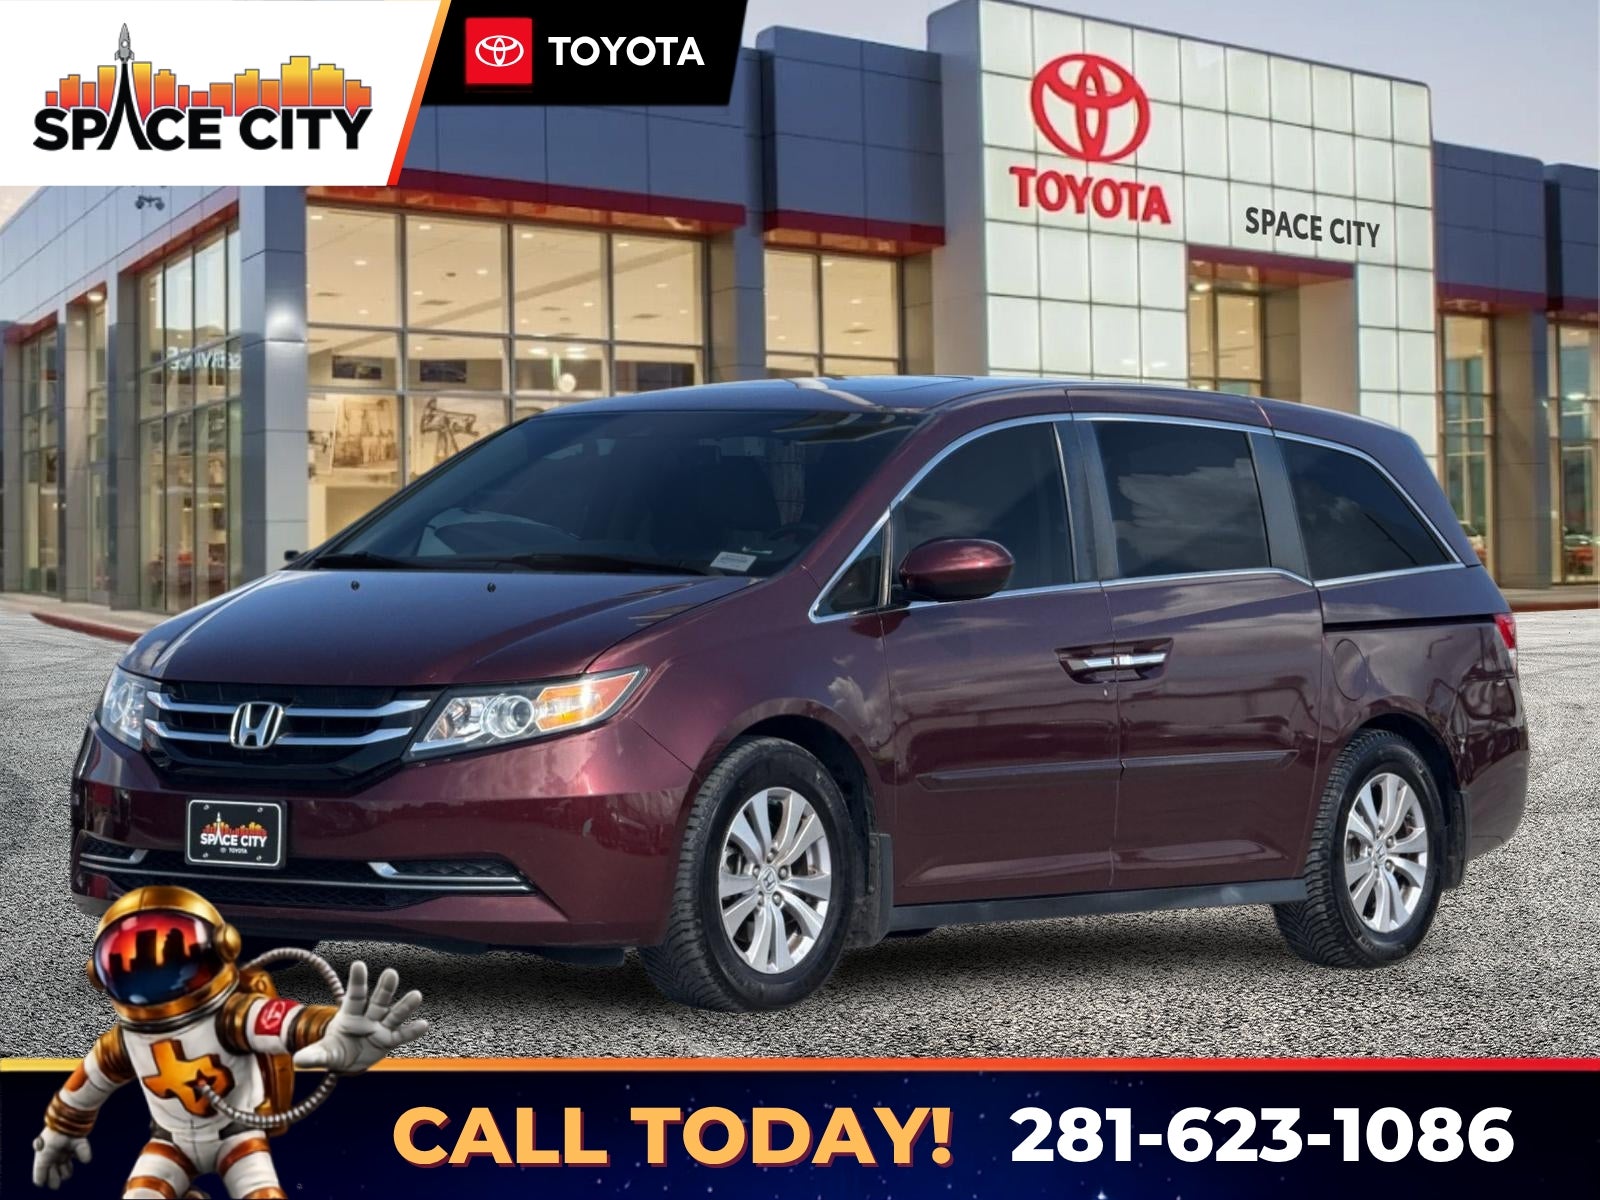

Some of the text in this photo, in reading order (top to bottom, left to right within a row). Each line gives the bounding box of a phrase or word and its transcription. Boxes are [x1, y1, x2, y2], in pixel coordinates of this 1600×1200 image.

[1009, 165, 1171, 225] TOYOTA
[1245, 207, 1380, 247] SPACE CITY
[200, 833, 267, 848] SPACE CITY
